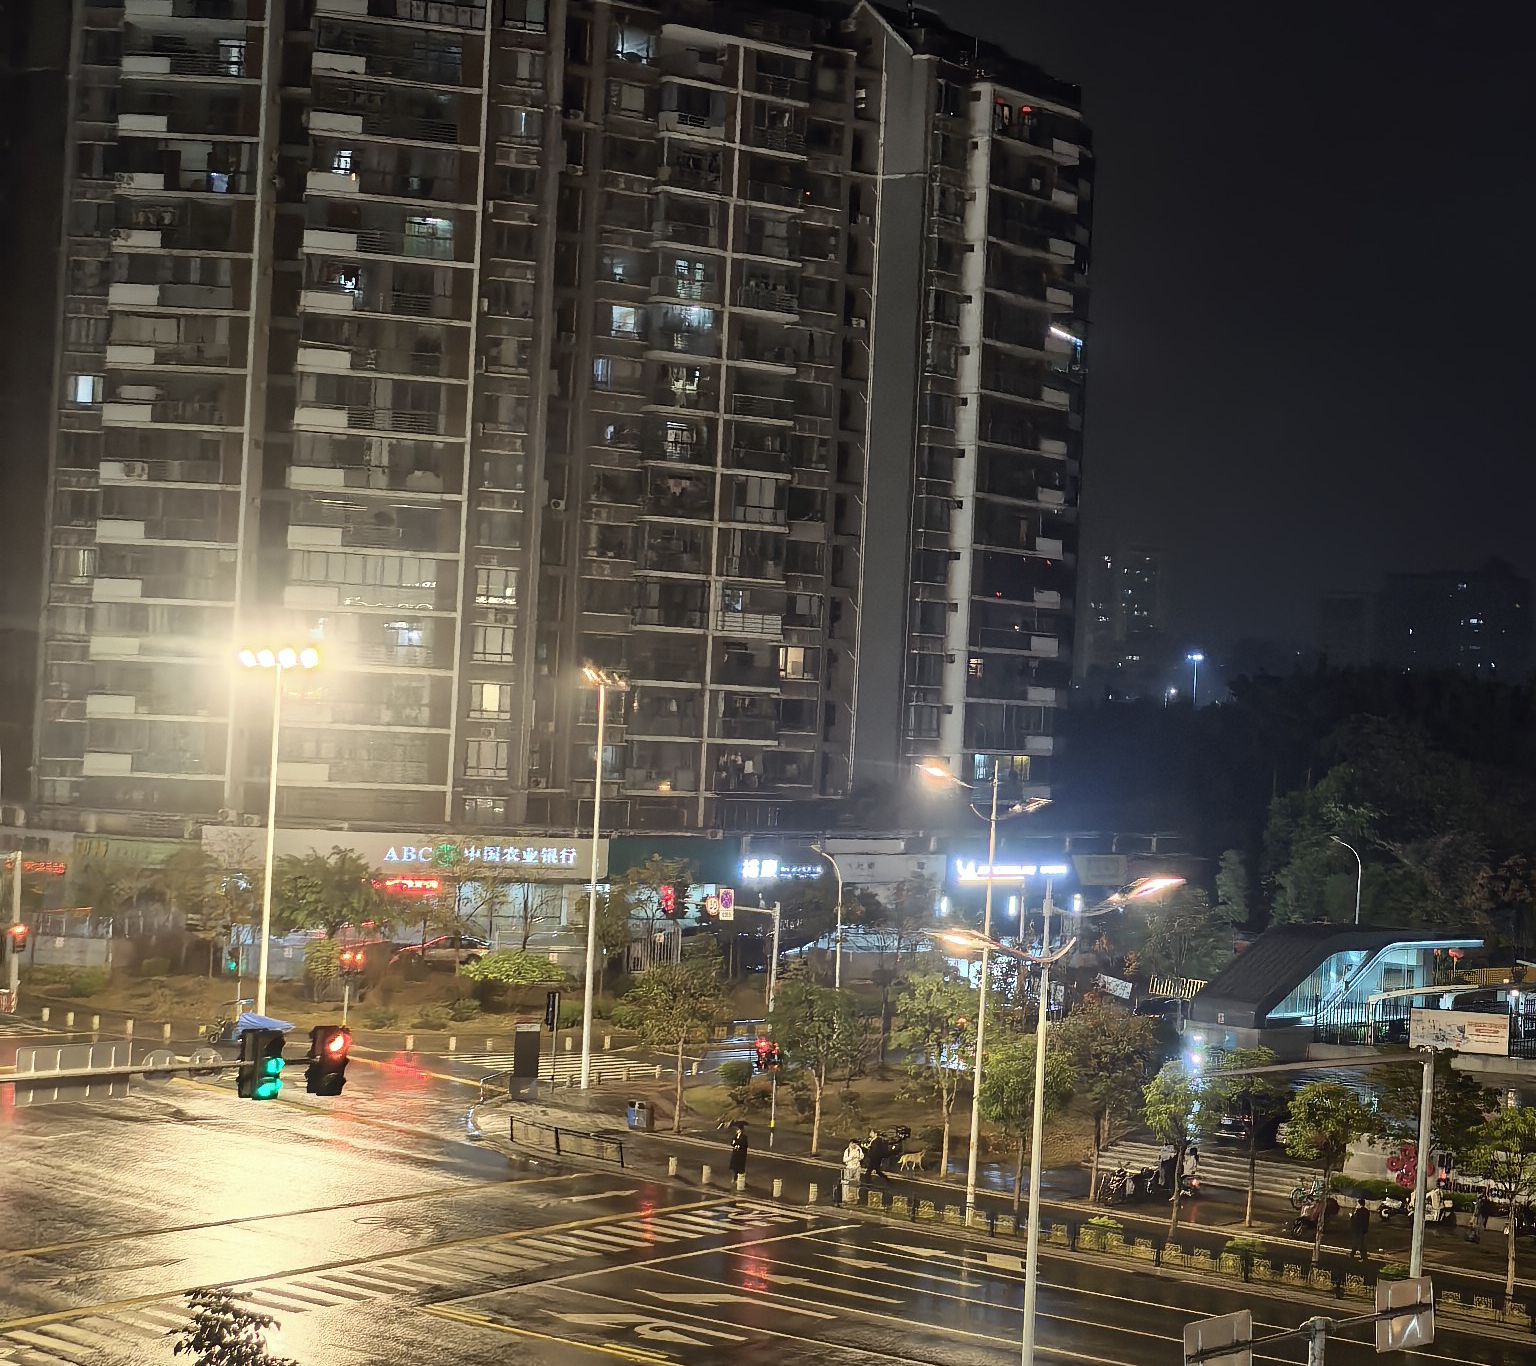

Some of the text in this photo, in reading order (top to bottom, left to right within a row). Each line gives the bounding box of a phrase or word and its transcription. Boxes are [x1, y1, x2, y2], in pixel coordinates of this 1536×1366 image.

[384, 845, 577, 864] ABC 中国农业银行
